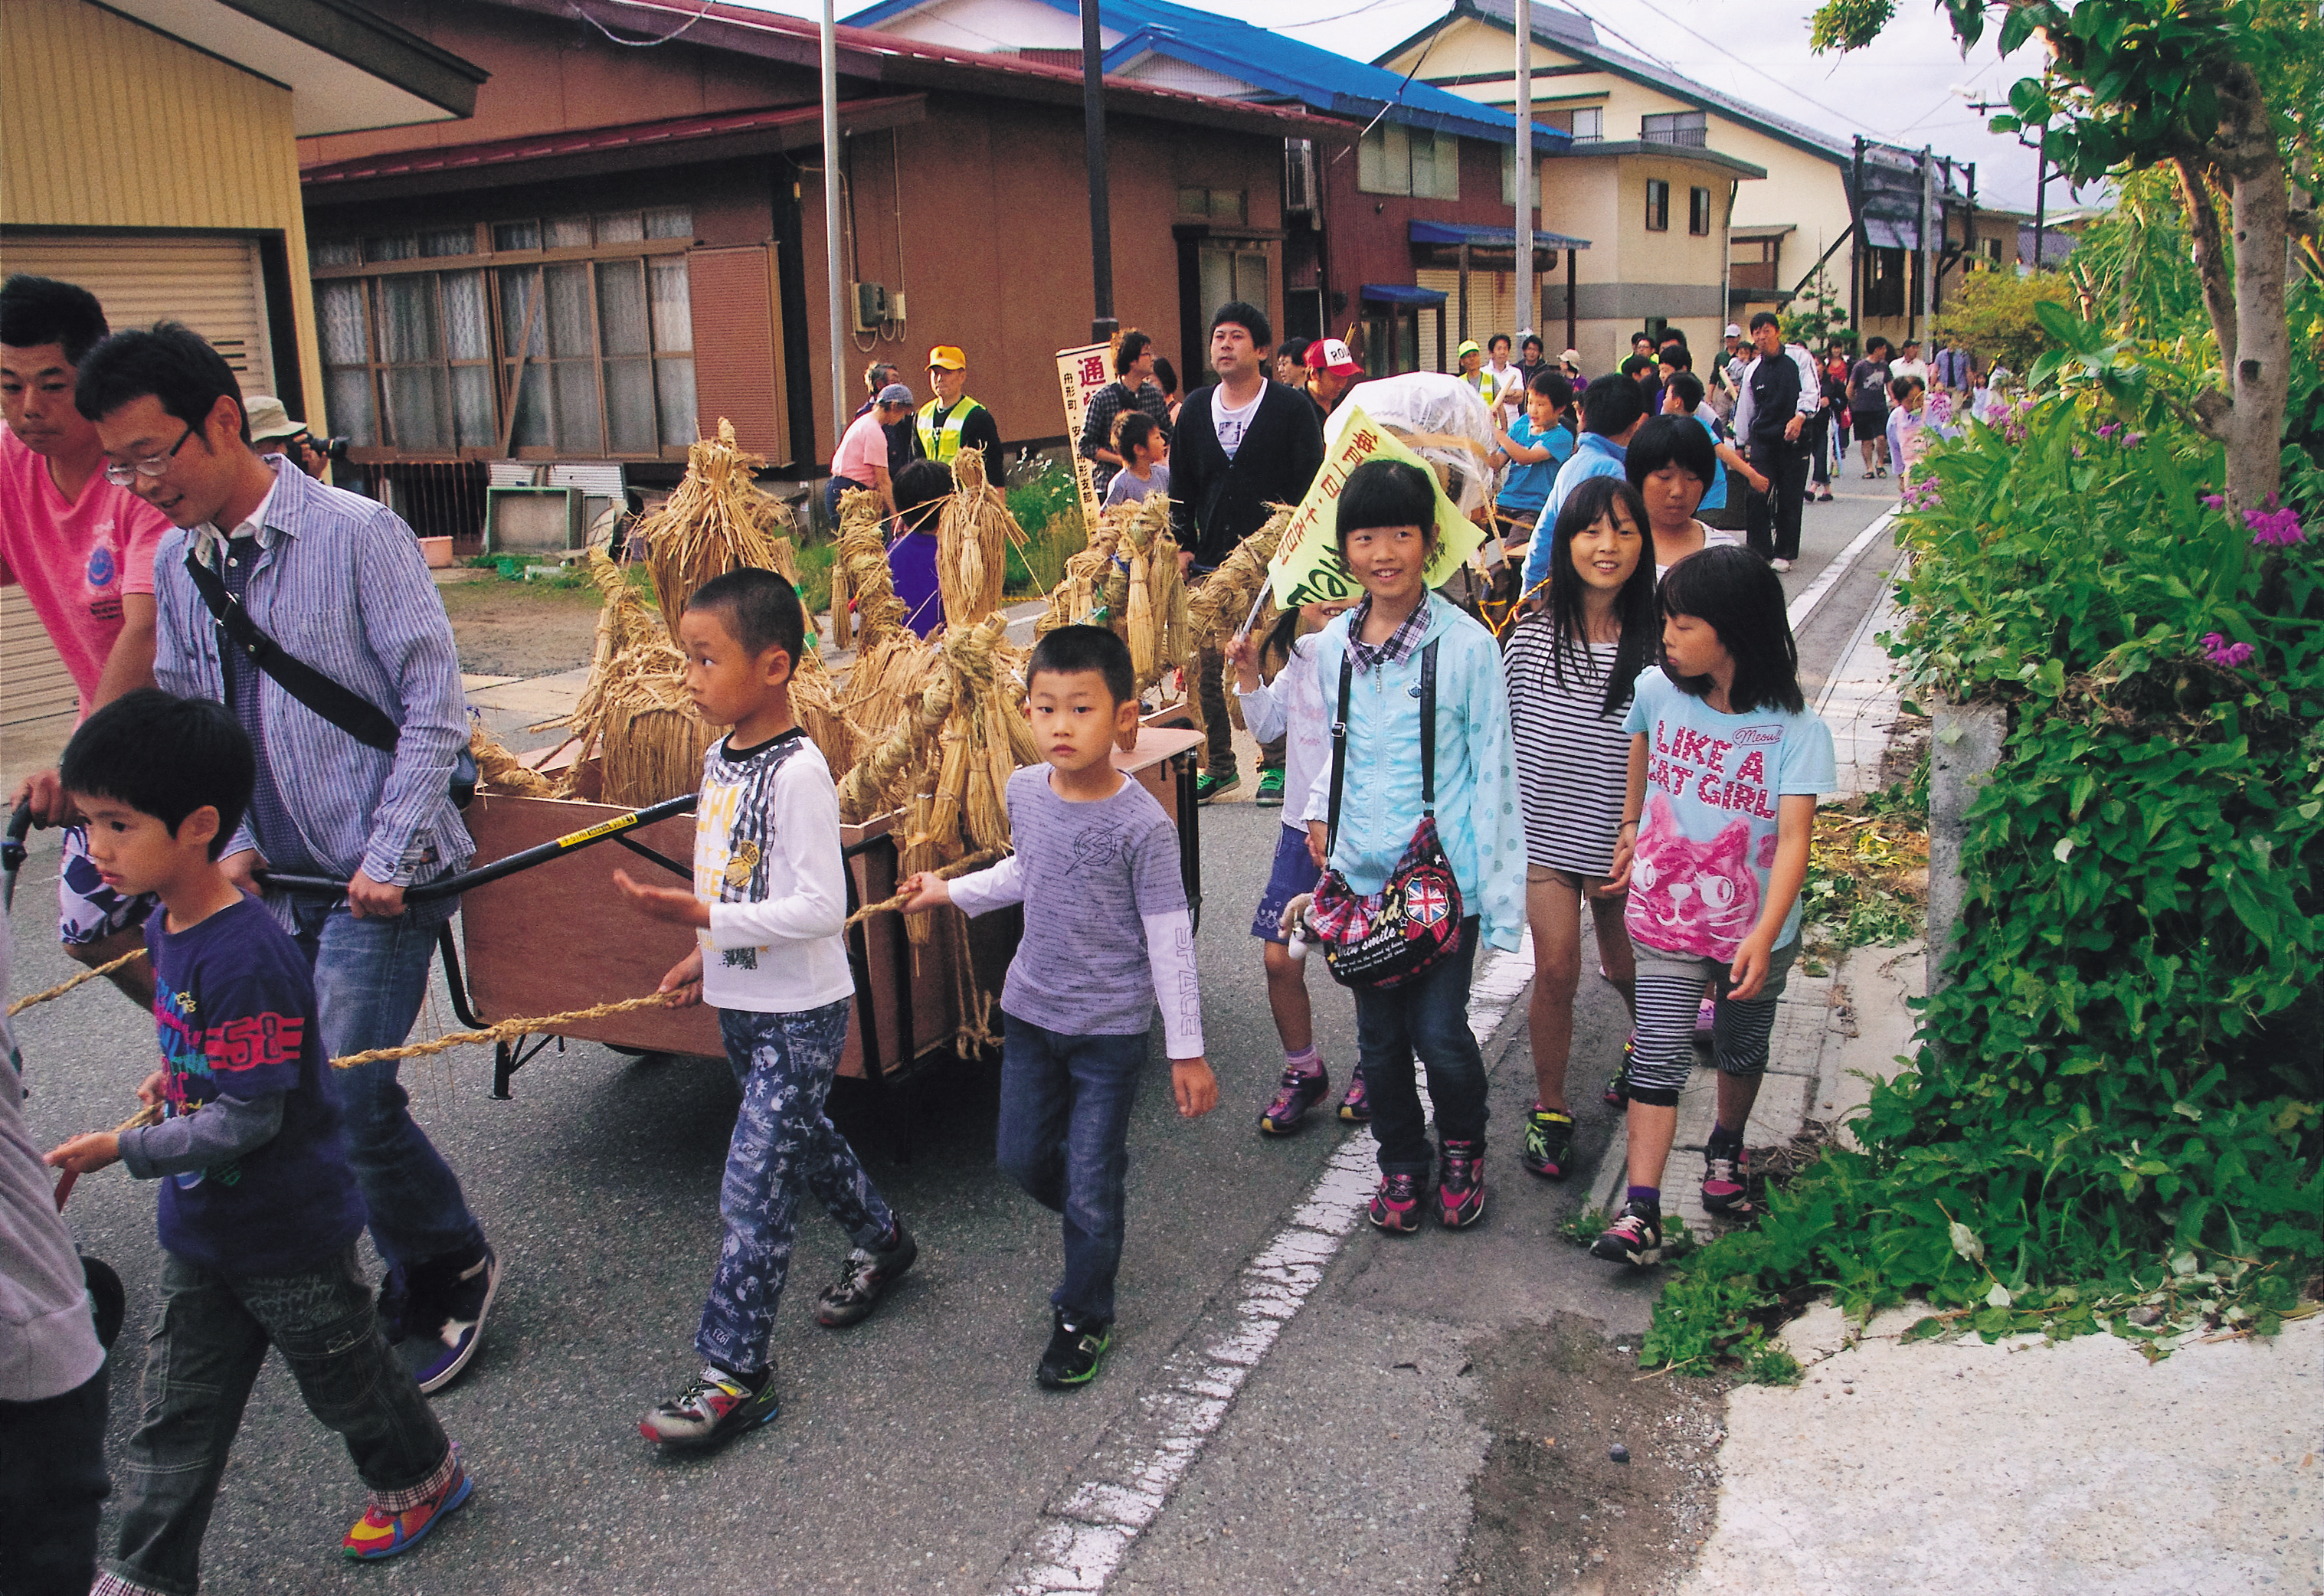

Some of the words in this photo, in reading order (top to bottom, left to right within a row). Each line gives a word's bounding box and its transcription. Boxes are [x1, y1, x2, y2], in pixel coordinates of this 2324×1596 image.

[1657, 720, 1733, 773] LIKE
[1736, 750, 1764, 785] A
[1697, 773, 1776, 819] GIRL
[1362, 925, 1396, 950] smile
